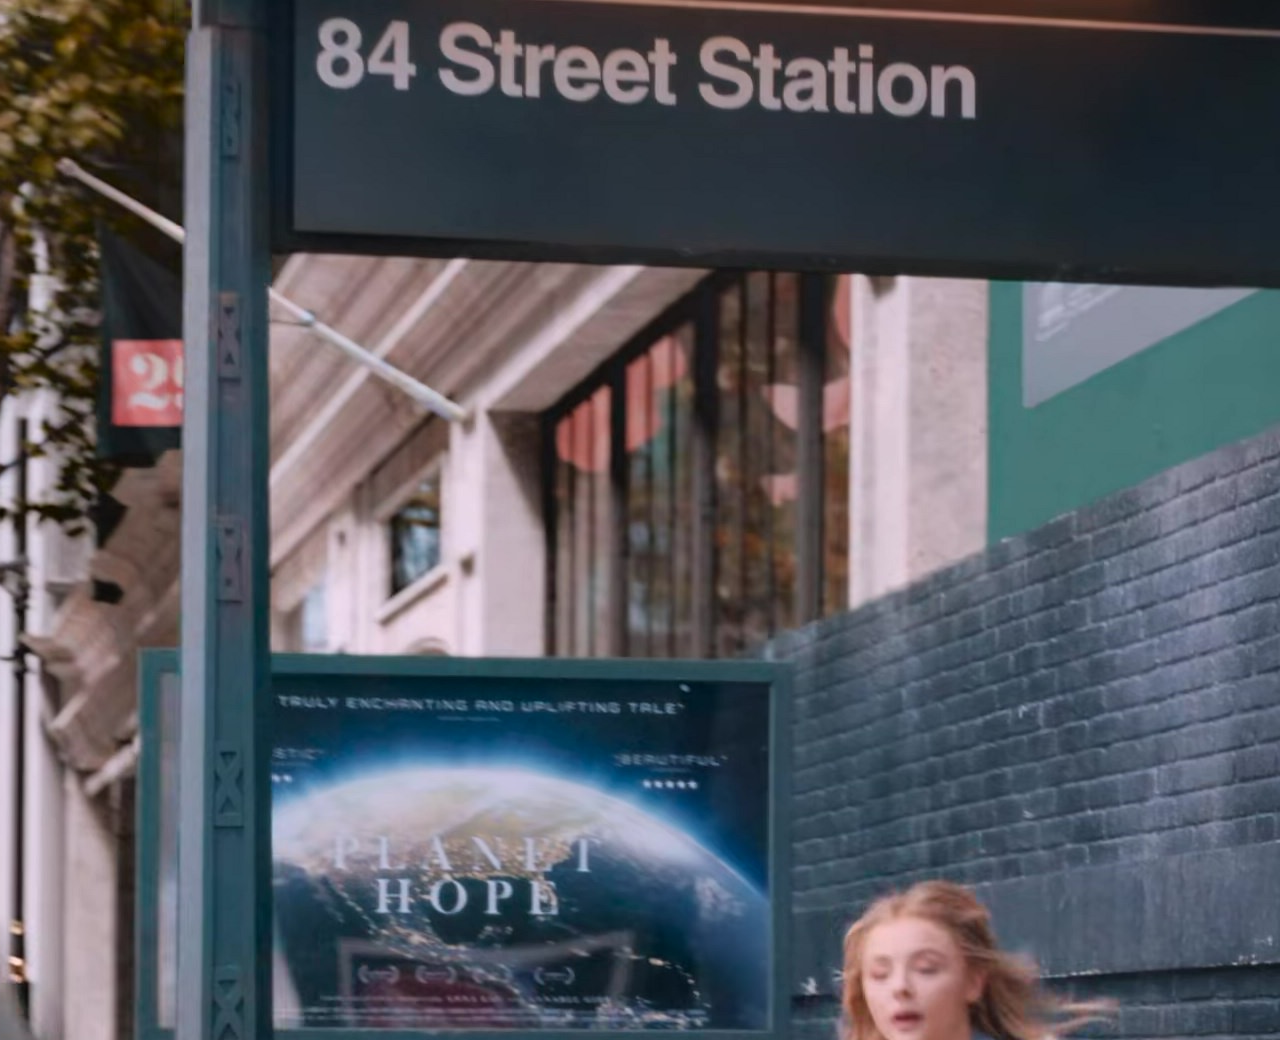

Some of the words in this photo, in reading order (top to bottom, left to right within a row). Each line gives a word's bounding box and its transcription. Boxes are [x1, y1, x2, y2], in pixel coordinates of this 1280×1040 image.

[315, 17, 417, 91] 84
[437, 21, 678, 106] Street
[698, 35, 977, 119] Station
[127, 351, 183, 411] 2
[345, 696, 469, 711] ENCHANTING
[475, 699, 515, 712] AND
[520, 700, 621, 714] UPLIFTING
[332, 834, 602, 873] PLANET
[373, 877, 560, 916] HOPE
